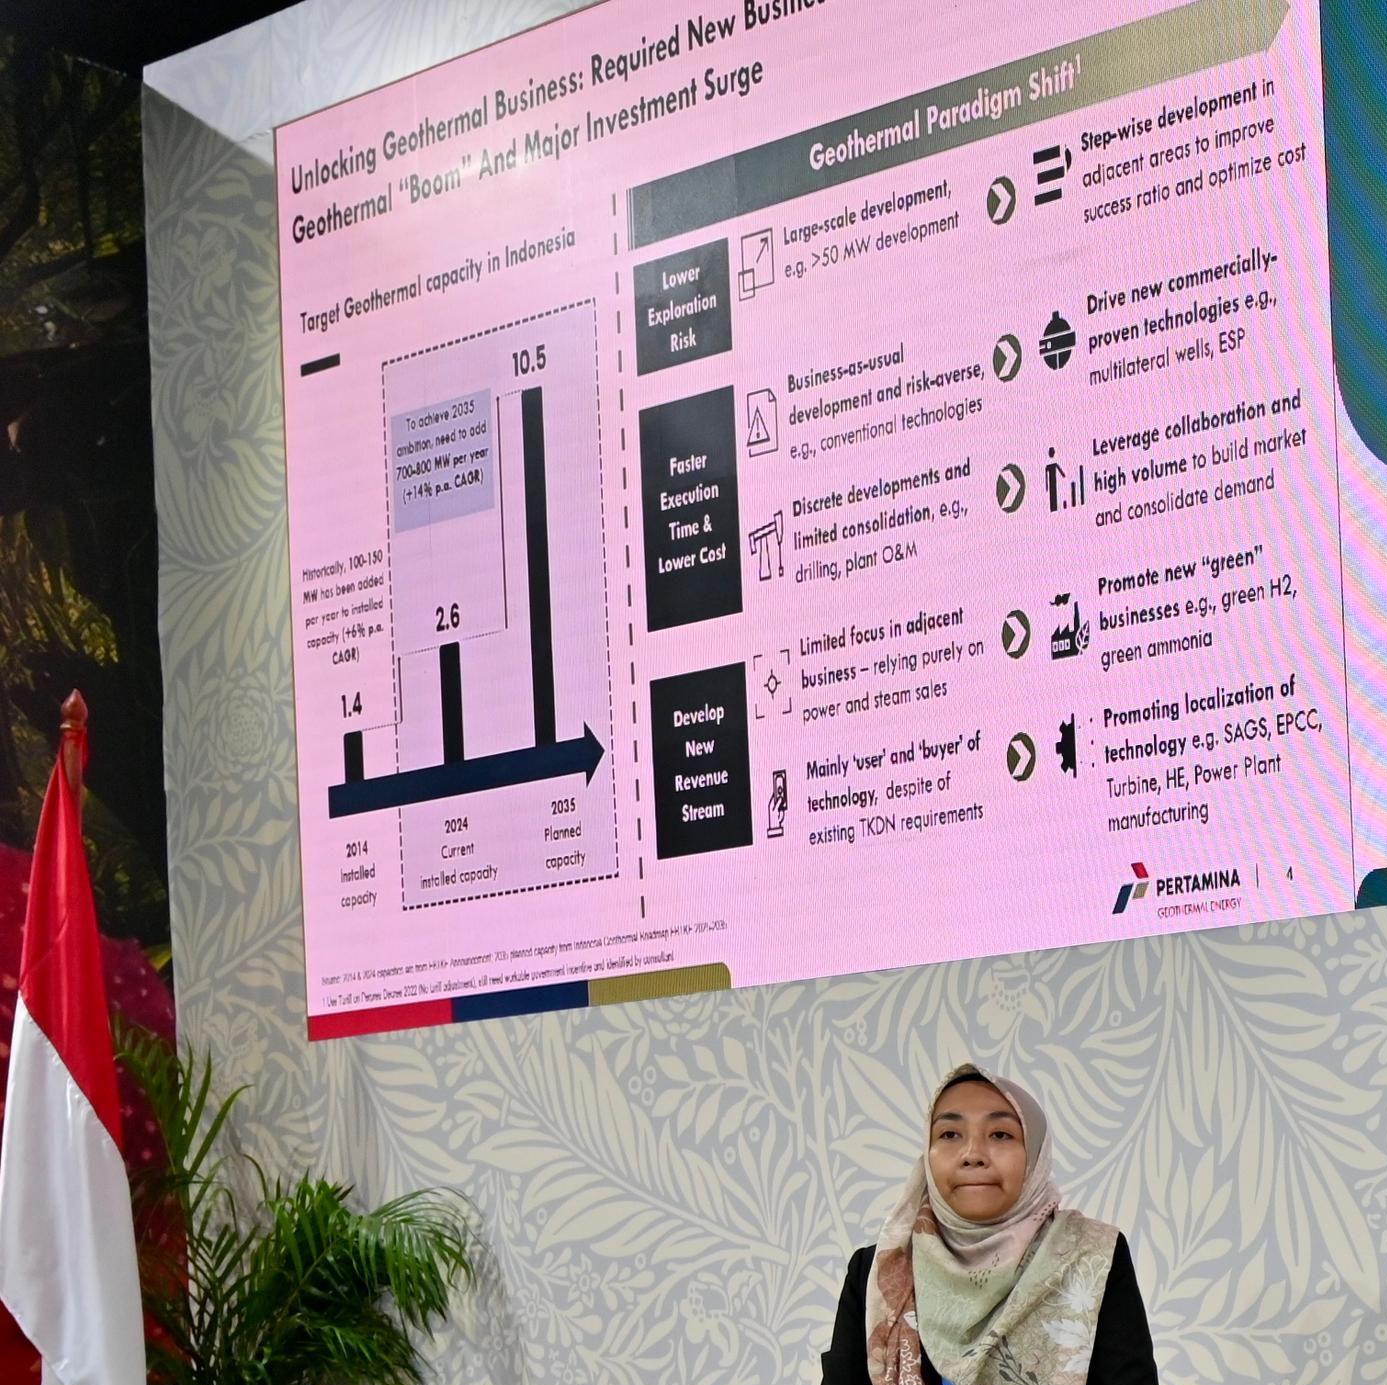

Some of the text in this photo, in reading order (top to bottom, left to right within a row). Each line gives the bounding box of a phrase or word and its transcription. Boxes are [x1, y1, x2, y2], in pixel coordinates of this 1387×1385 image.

[290, 15, 736, 196] Unlocking Geothermal Business: Required New
[926, 86, 1022, 135] Paradigm
[1080, 81, 1257, 152] Step-wise development
[291, 61, 764, 244] Geothermal Major Surge
[1081, 142, 1191, 189] adjacent areas
[1083, 155, 1272, 224] success ratio optimize
[783, 206, 857, 246] Large-scale
[875, 210, 960, 251] development
[299, 226, 576, 333] Target Geothermal Indonesia
[662, 267, 700, 291] Lower
[647, 294, 717, 328] Exploration
[1088, 296, 1240, 354] proven technologies
[512, 343, 547, 377] 10.5
[787, 342, 904, 394] Business-as-usual
[820, 397, 983, 452] conventional technologies
[1092, 428, 1160, 457] Leverage
[1093, 427, 1307, 495] high volume build market
[660, 482, 719, 512] Execution
[792, 468, 941, 517] Discrete developments
[1213, 468, 1275, 502] demand
[668, 514, 713, 540] Time &
[793, 522, 838, 550] limited
[658, 542, 727, 574] Lower Cost
[1097, 568, 1159, 596] Promote
[435, 602, 460, 633] 2.6
[1099, 585, 1265, 631] businesses green
[799, 607, 964, 657] Limited focus adjacent
[801, 640, 963, 689] business purely
[1100, 632, 1213, 673] green ammonia
[341, 691, 363, 718] 1.4
[802, 682, 948, 722] power steam sales
[1184, 682, 1274, 714] localization
[673, 703, 725, 728] Develop
[685, 739, 715, 757] New
[1104, 733, 1187, 764] technology
[674, 770, 729, 792] Revenue
[806, 754, 849, 780] Mainly
[1194, 753, 1282, 786] Power Plant
[885, 778, 933, 800] despite
[551, 796, 576, 816] 2035
[681, 803, 725, 823] Stream
[859, 803, 984, 836] TKDN requirements
[1108, 801, 1209, 832] manufacturing
[544, 825, 582, 842] Planned
[341, 863, 376, 882] Installed
[545, 850, 586, 871] capacity
[420, 865, 498, 889] installed capacity
[1156, 868, 1241, 897] PERTAMINA
